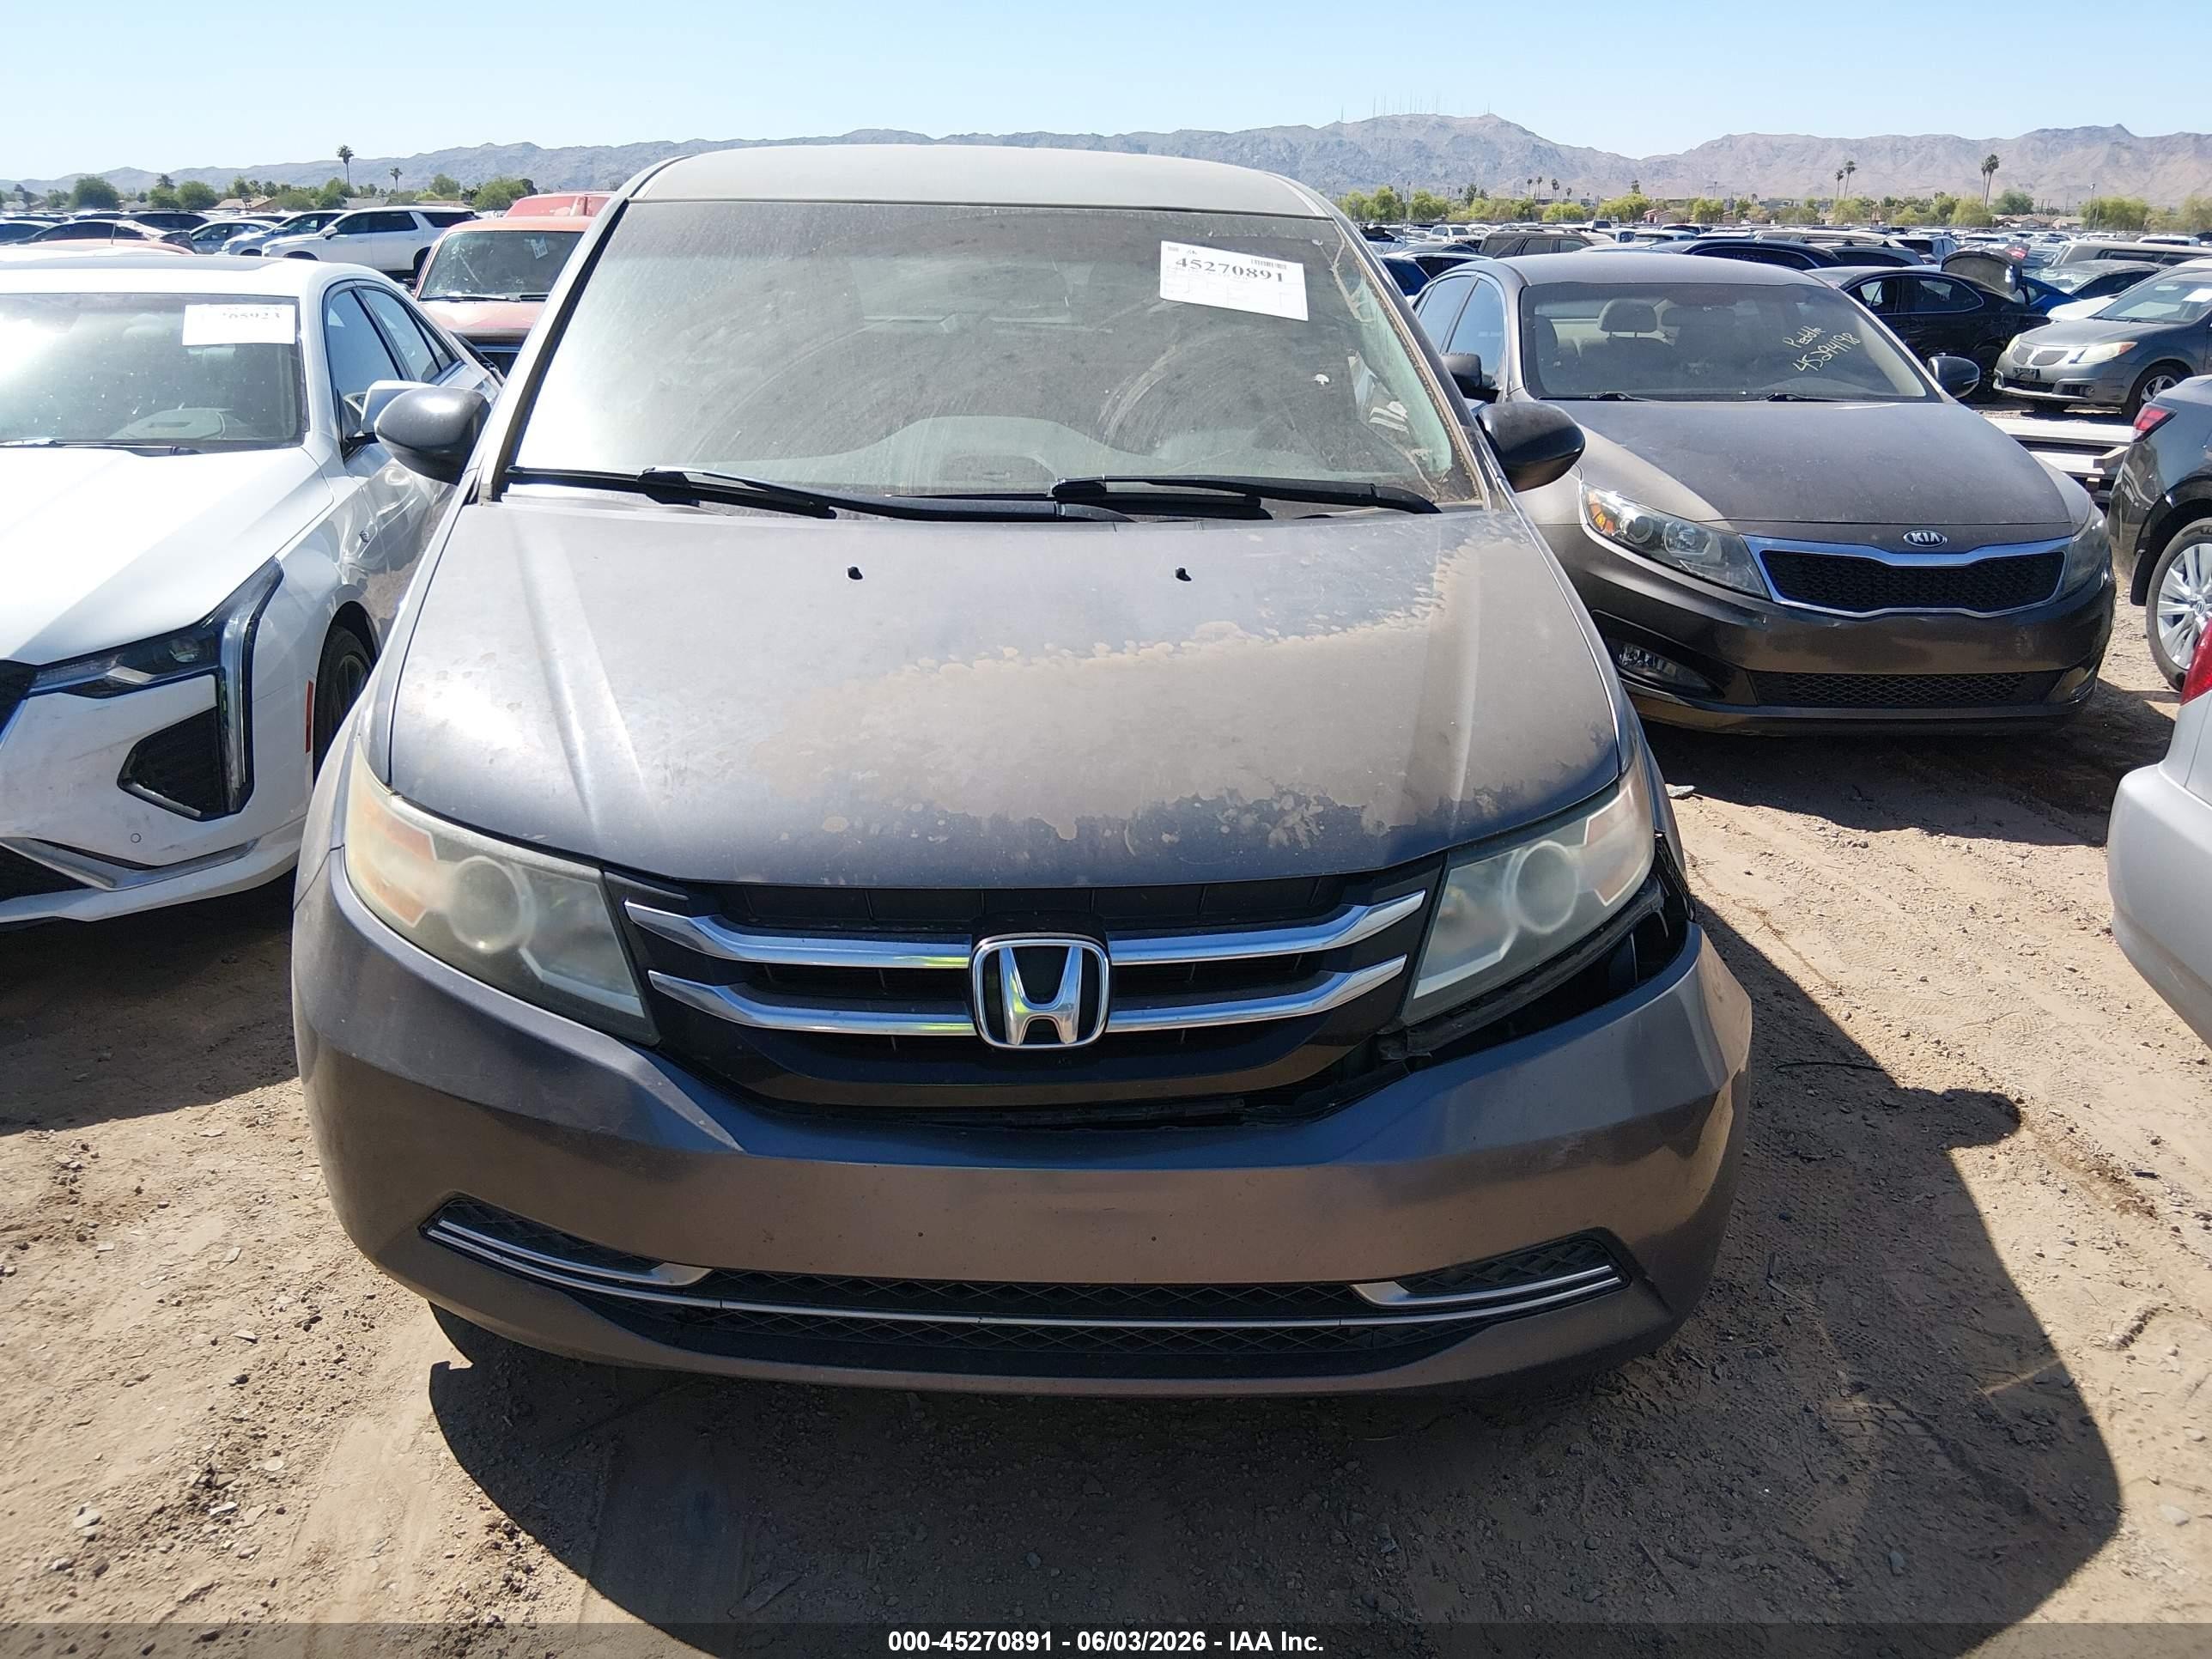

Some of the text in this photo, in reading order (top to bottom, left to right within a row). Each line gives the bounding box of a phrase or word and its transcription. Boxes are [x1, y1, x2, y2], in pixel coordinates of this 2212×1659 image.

[1176, 258, 1283, 283] 45270891
[1793, 332, 1861, 372] 45294198
[1911, 532, 1940, 543] KIA
